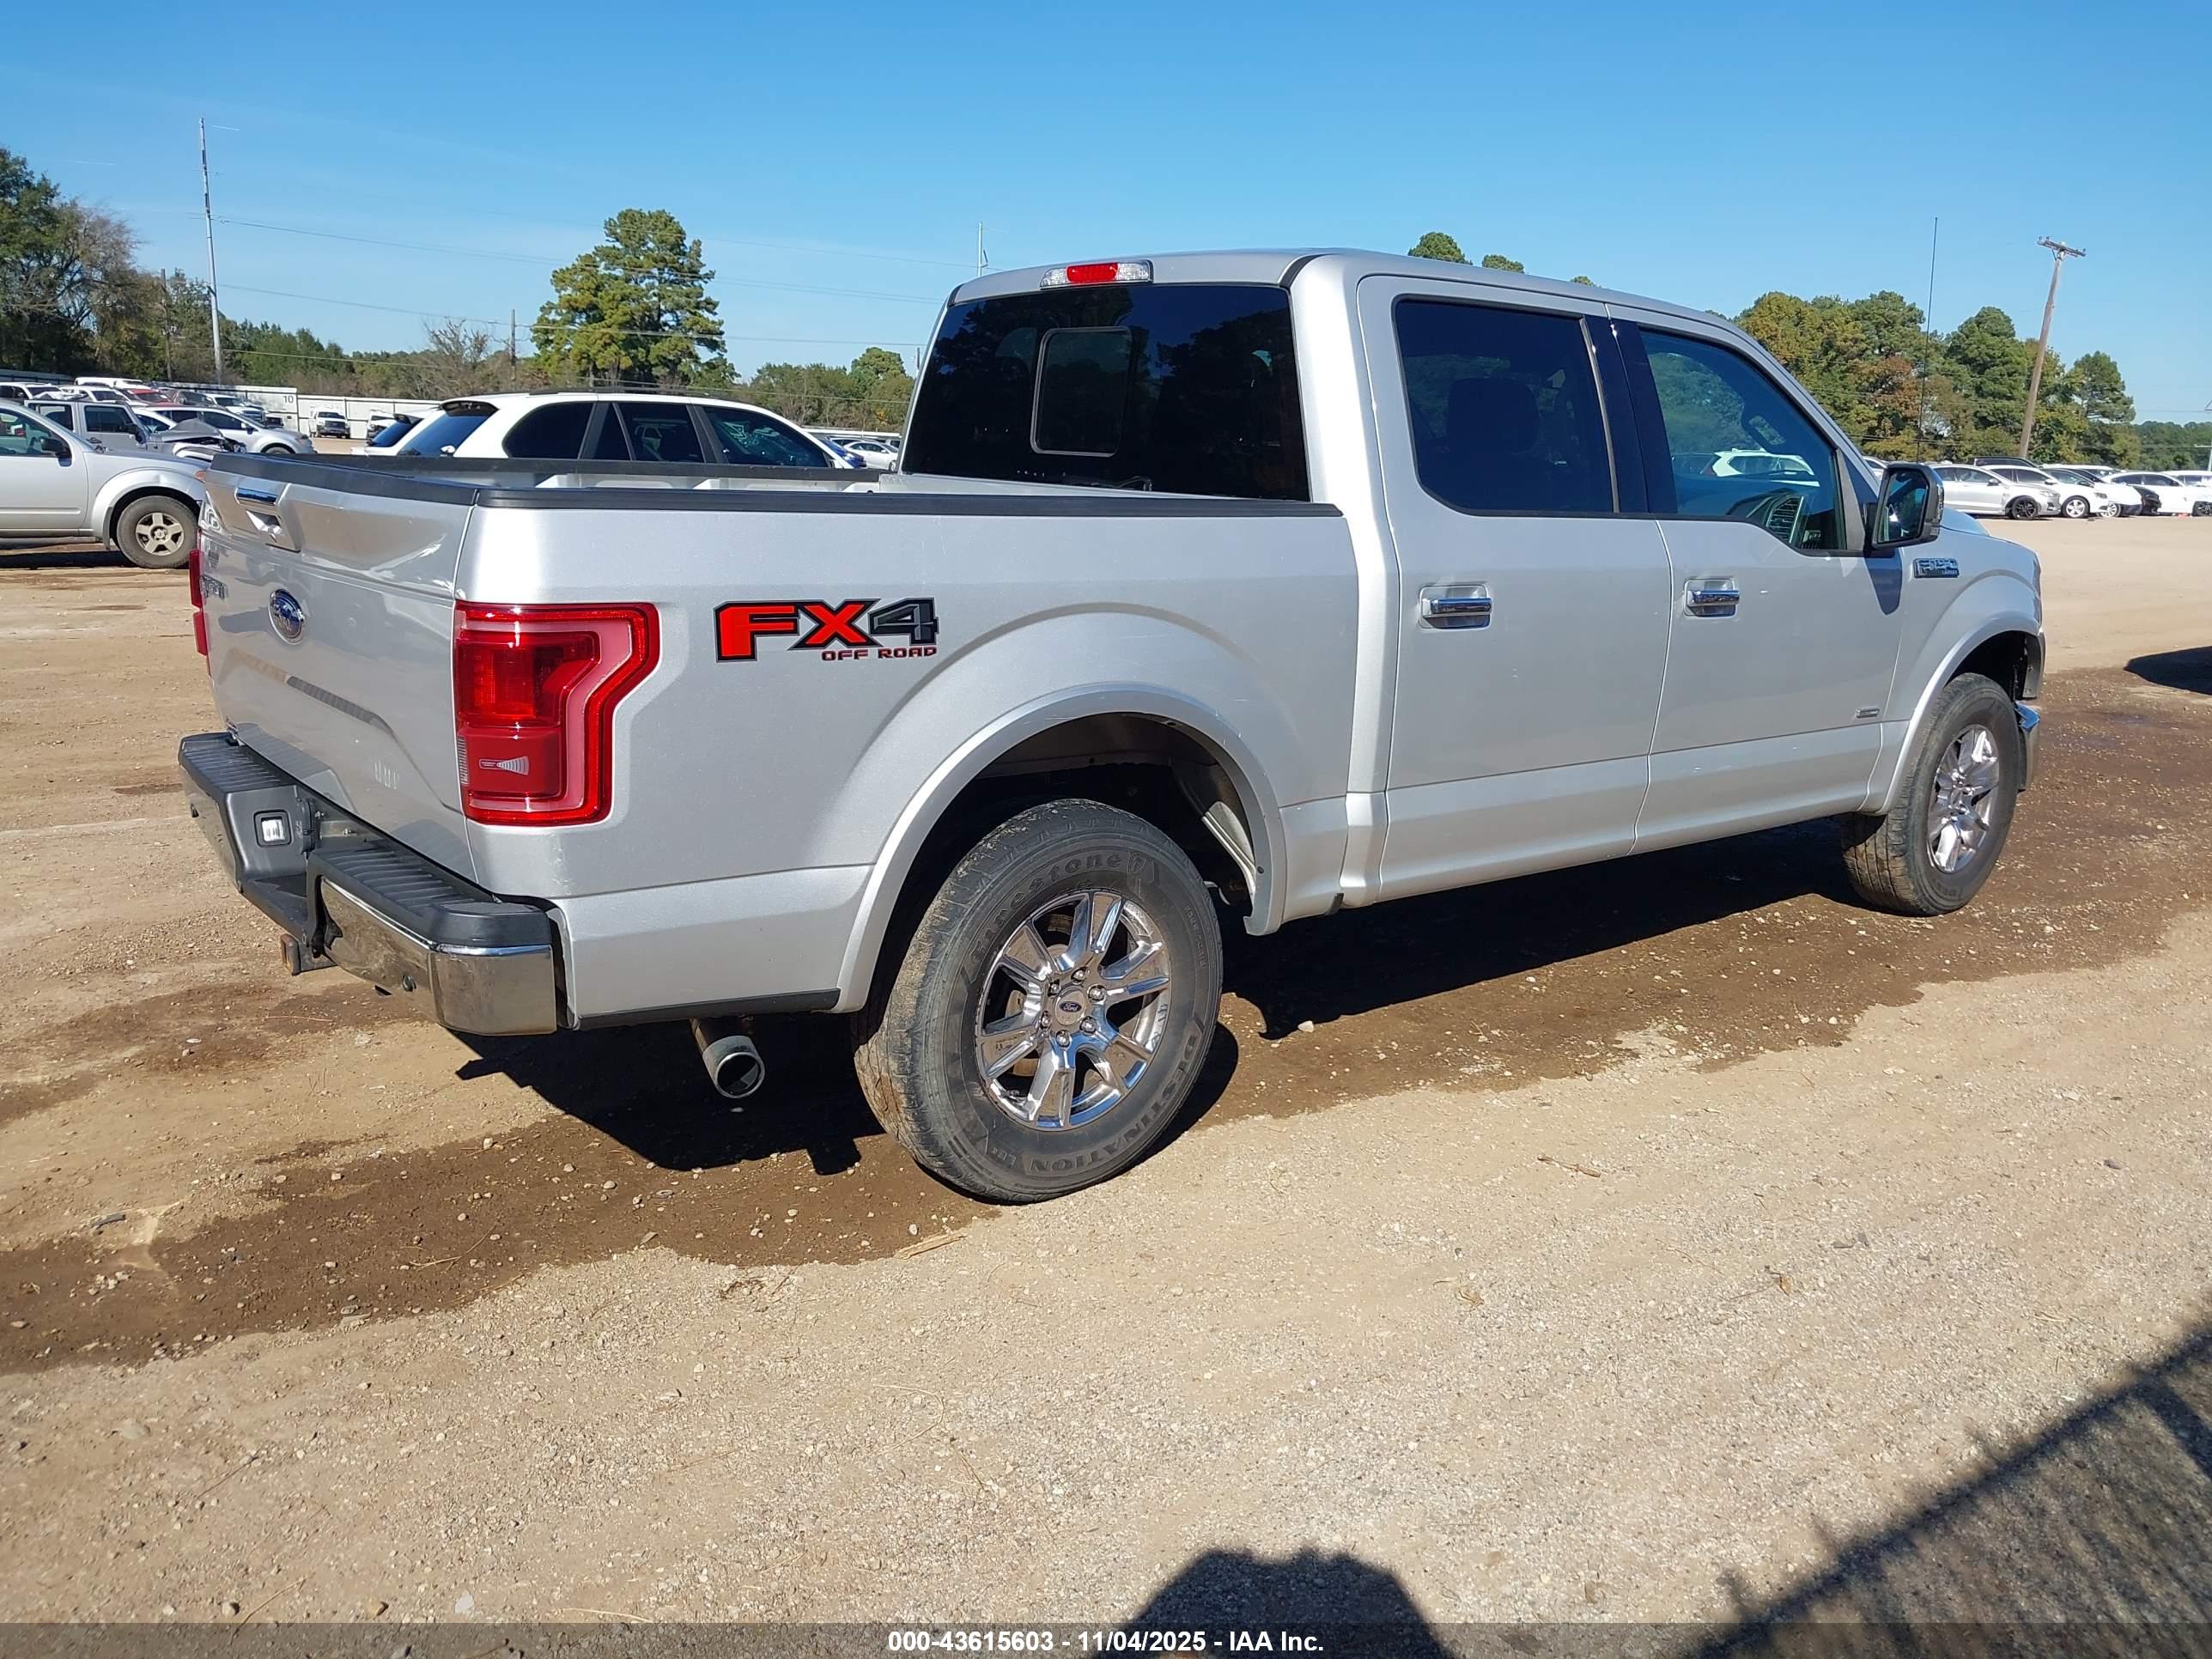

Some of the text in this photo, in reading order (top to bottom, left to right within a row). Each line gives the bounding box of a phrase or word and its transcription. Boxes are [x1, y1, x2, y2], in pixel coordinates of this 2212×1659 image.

[283, 395, 294, 404] 10
[714, 598, 939, 663] FX4
[822, 646, 938, 662] OFF ROAD
[1061, 1002, 1080, 1012] Ford
[1030, 1034, 1199, 1172] DESTINATION
